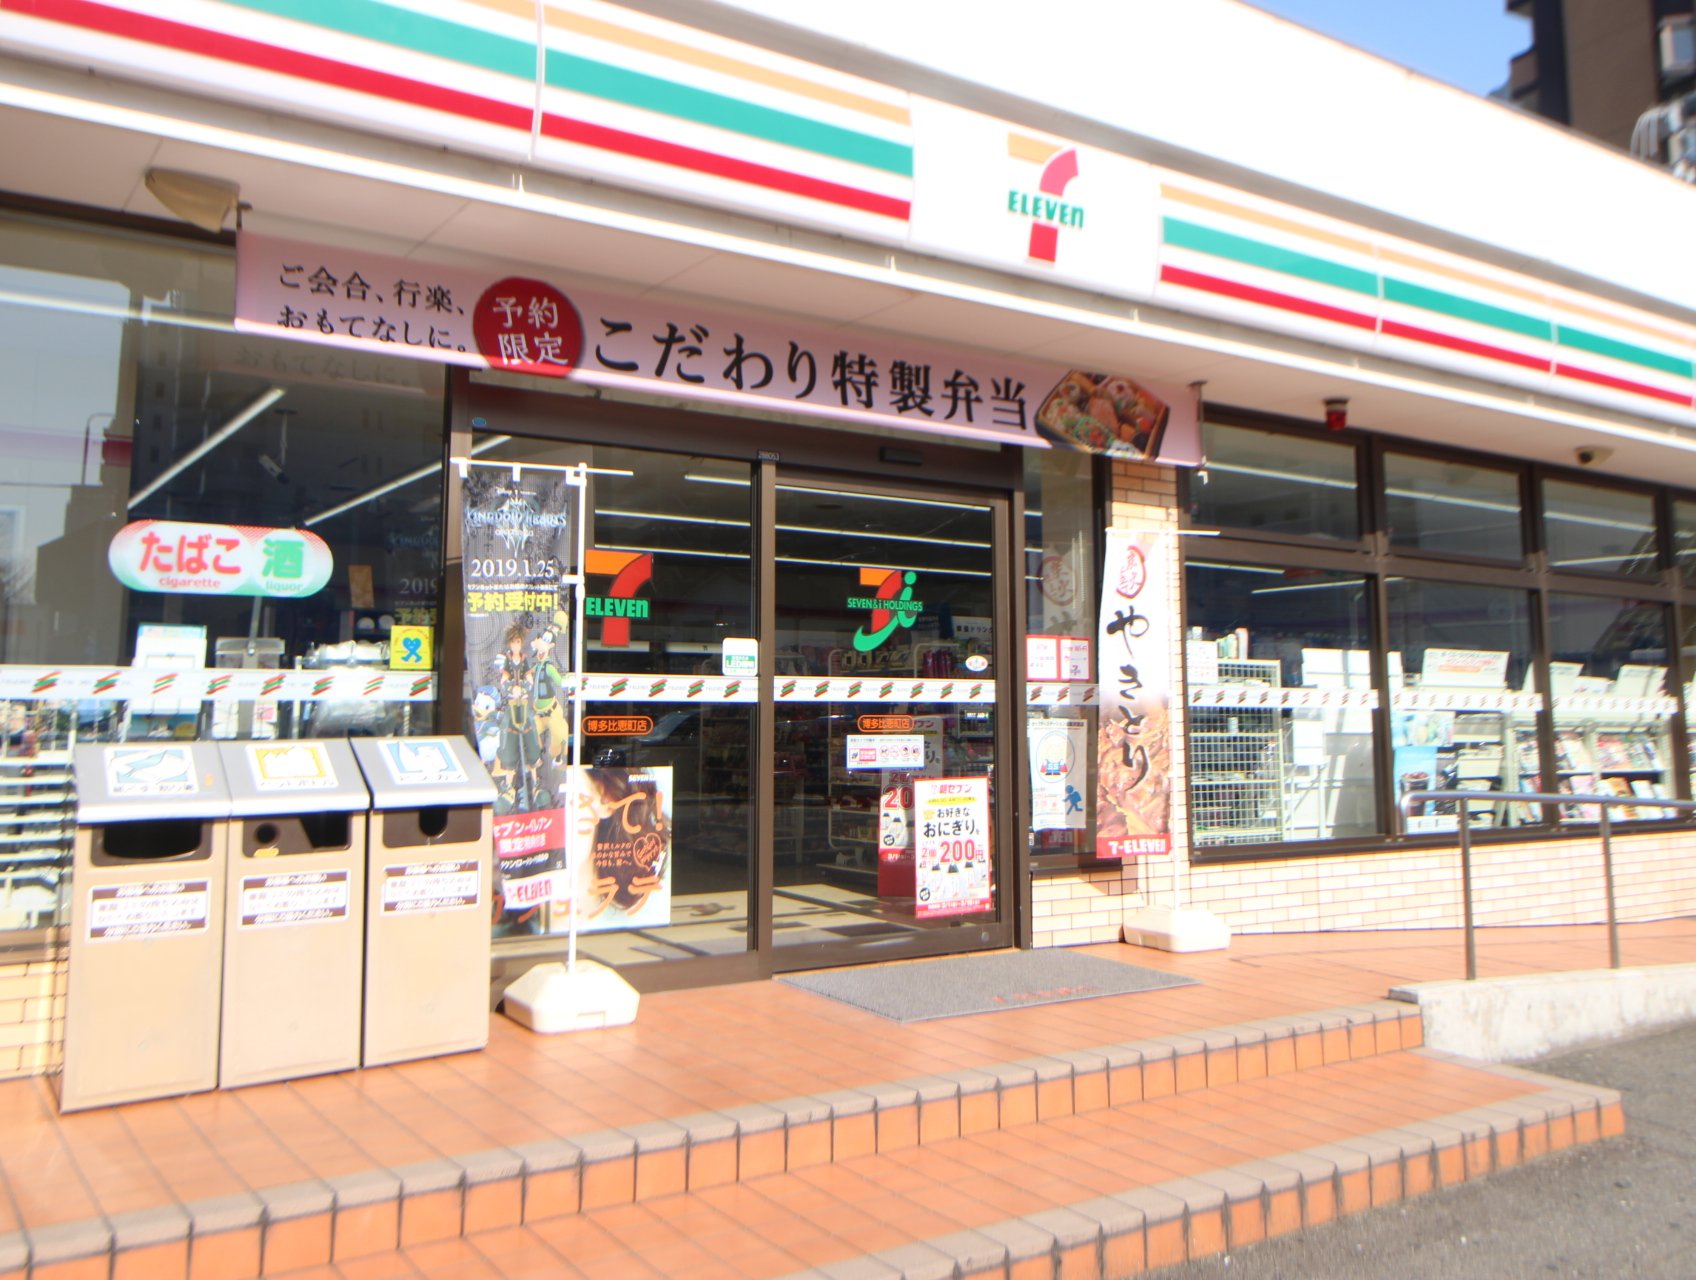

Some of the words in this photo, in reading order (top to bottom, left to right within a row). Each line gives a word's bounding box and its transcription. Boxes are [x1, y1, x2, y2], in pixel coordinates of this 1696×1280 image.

[280, 263, 465, 316] ご会合、行楽、
[277, 305, 469, 354] おもてなしに。
[492, 296, 560, 331] 予約
[498, 332, 570, 368] 限定
[595, 316, 1029, 430] こだわり特製弁当
[139, 531, 242, 575] たばこ
[262, 538, 304, 579] 酒
[471, 558, 554, 578] 2019.1.25
[159, 577, 220, 590] cigarette
[266, 580, 303, 592] liquor
[883, 601, 924, 612] HOLDINGS
[1106, 605, 1150, 792] やきとり
[937, 807, 970, 818] お好きな
